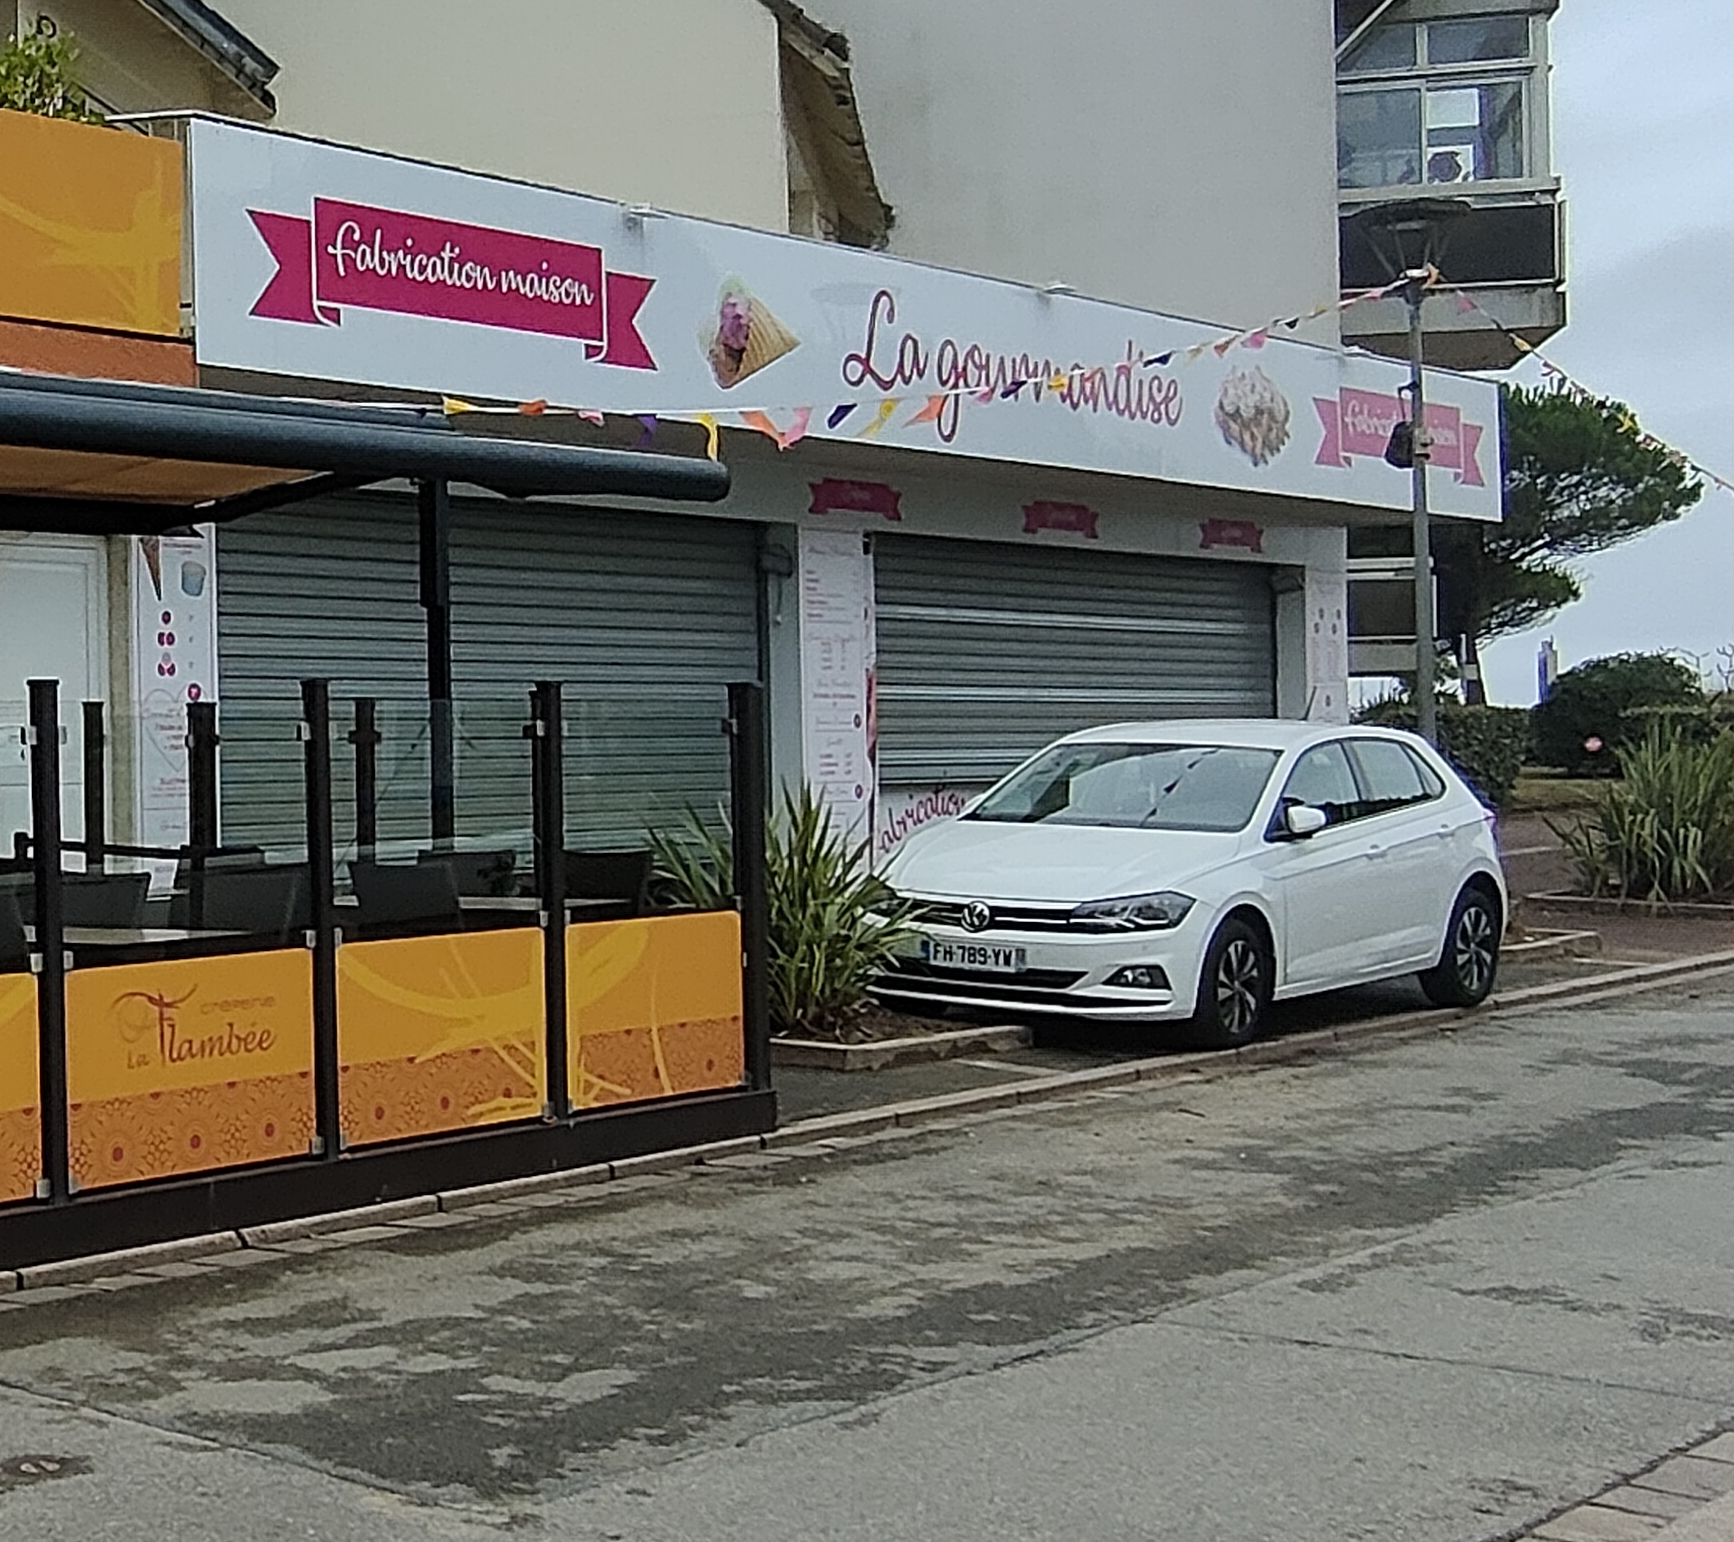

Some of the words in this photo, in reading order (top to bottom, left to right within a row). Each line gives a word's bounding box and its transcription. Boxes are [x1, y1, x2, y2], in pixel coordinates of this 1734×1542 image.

[500, 261, 595, 307] maison
[841, 289, 930, 393] La
[936, 338, 1184, 444] gourmandise
[120, 983, 277, 1068] Flambée
